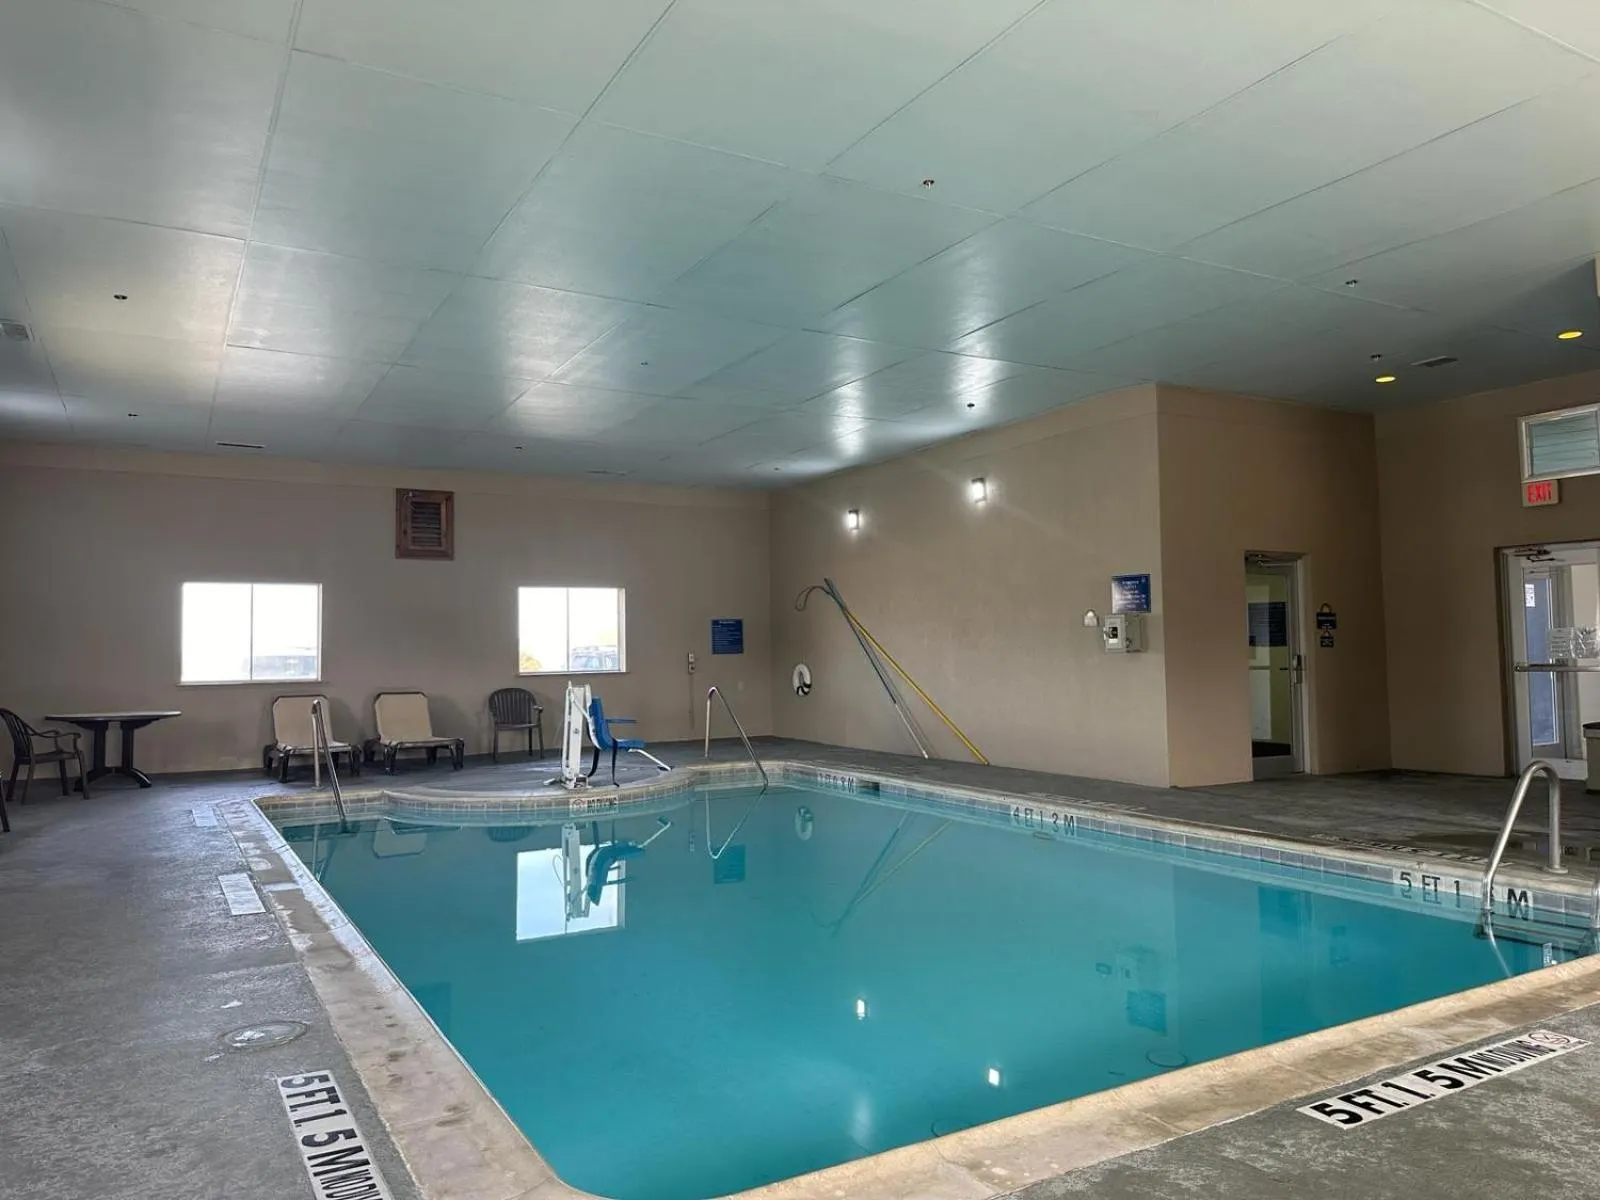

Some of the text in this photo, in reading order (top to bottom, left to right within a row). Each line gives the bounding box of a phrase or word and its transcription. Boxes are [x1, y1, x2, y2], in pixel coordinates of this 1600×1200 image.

[1527, 481, 1553, 504] EXIT
[1063, 814, 1074, 827] M
[1400, 871, 1412, 888] 5
[1421, 875, 1441, 893] FT
[1506, 888, 1529, 906] M
[1309, 1102, 1363, 1125] 5
[1437, 1057, 1504, 1080] M
[280, 1074, 331, 1089] 5
[307, 1145, 371, 1177] M
